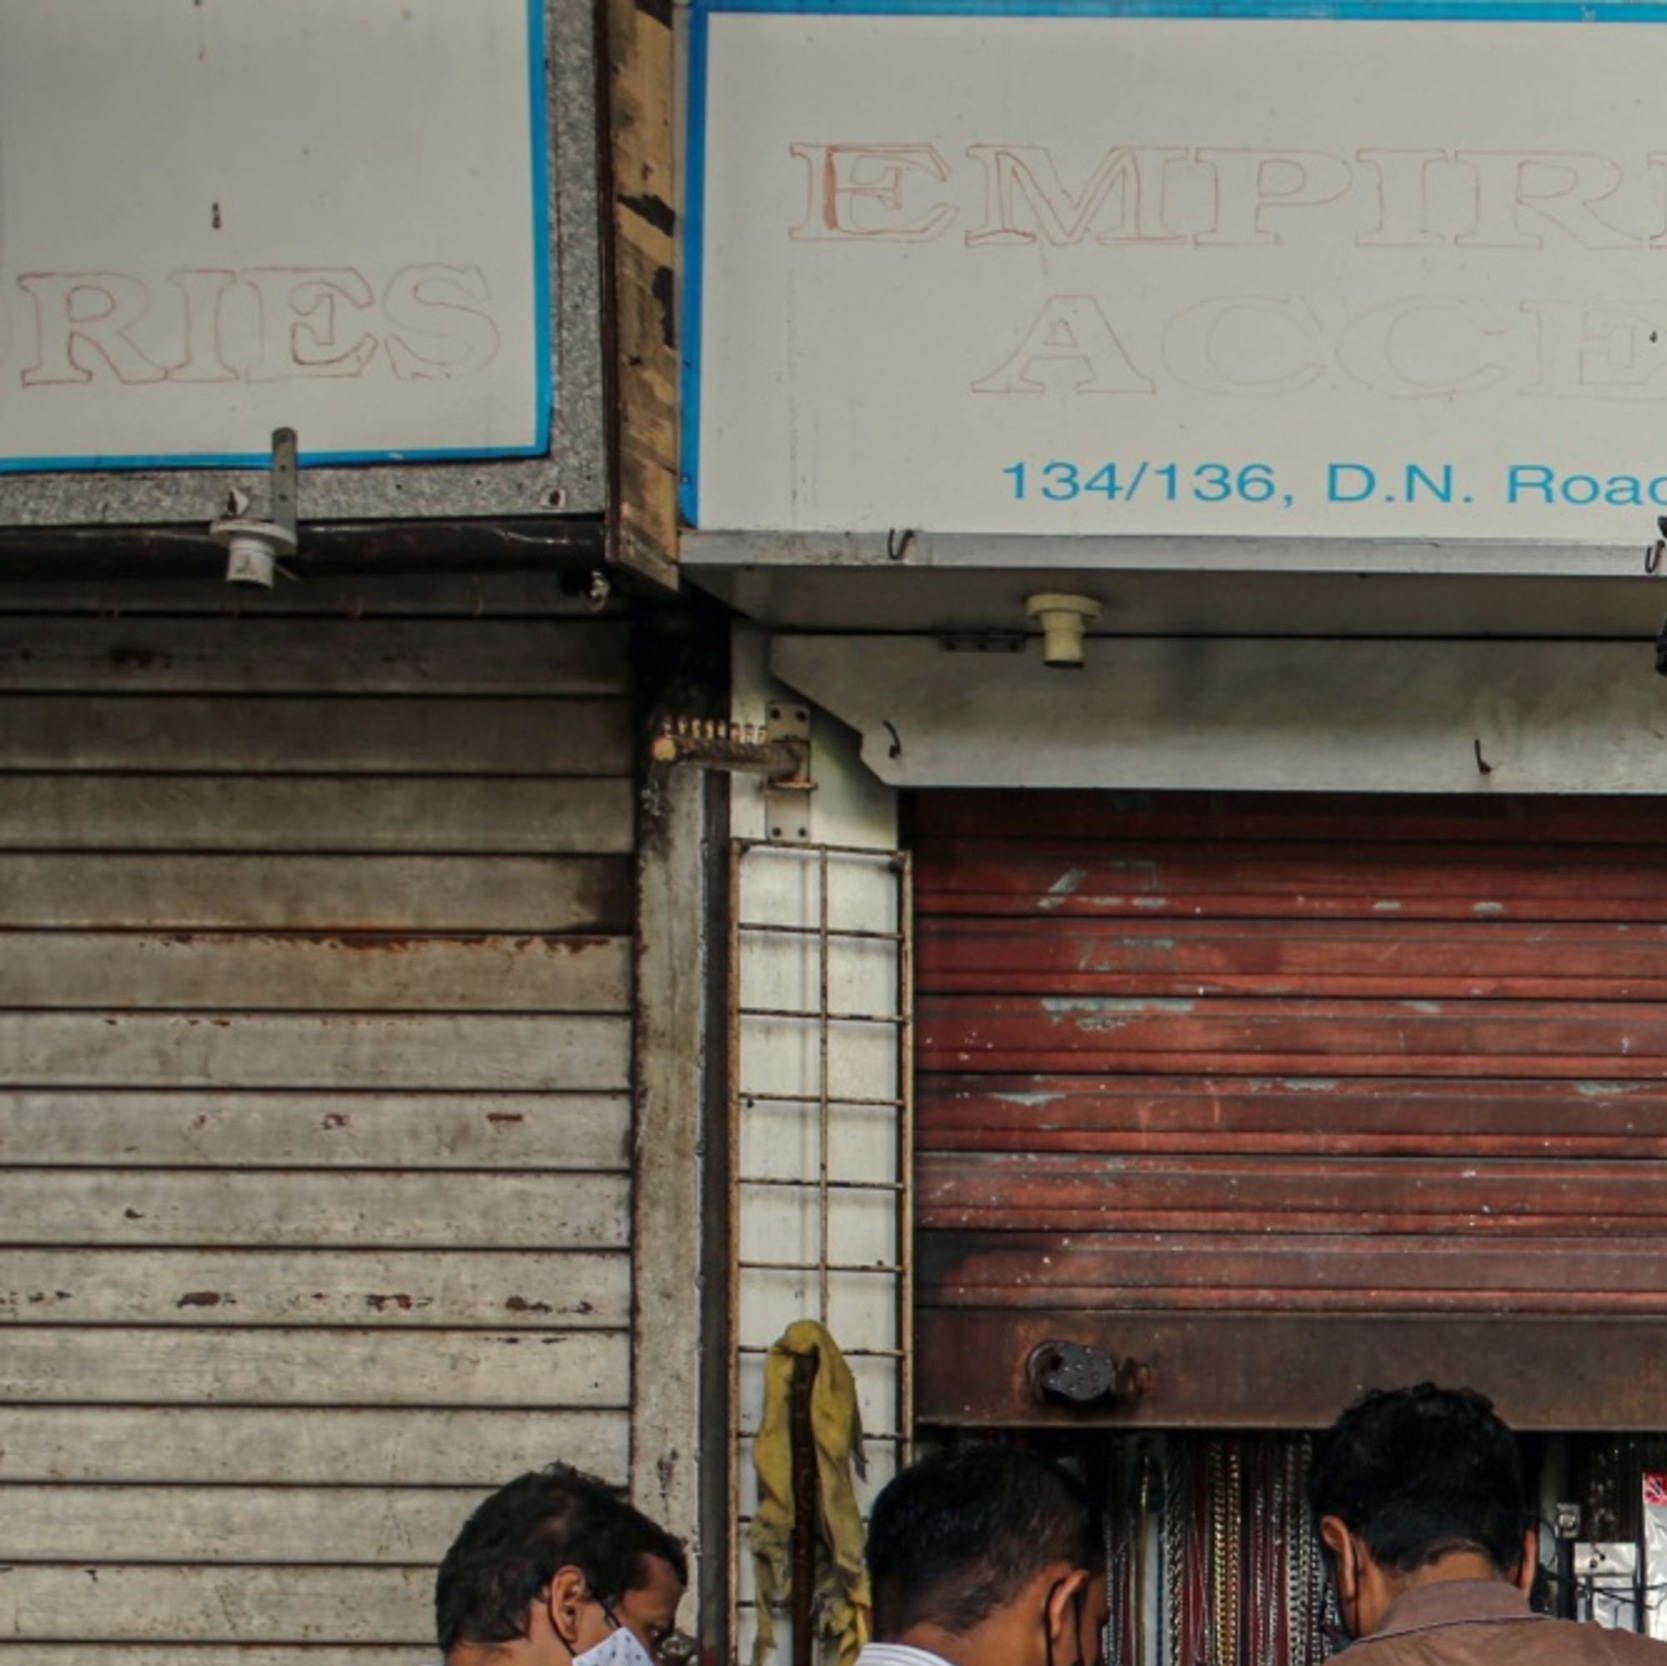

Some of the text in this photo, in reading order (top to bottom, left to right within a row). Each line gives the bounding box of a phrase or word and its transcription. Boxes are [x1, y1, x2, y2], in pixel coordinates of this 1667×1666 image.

[0, 262, 501, 388] RIES
[1002, 461, 1294, 508] 134/136,
[1326, 463, 1474, 504] D.N.
